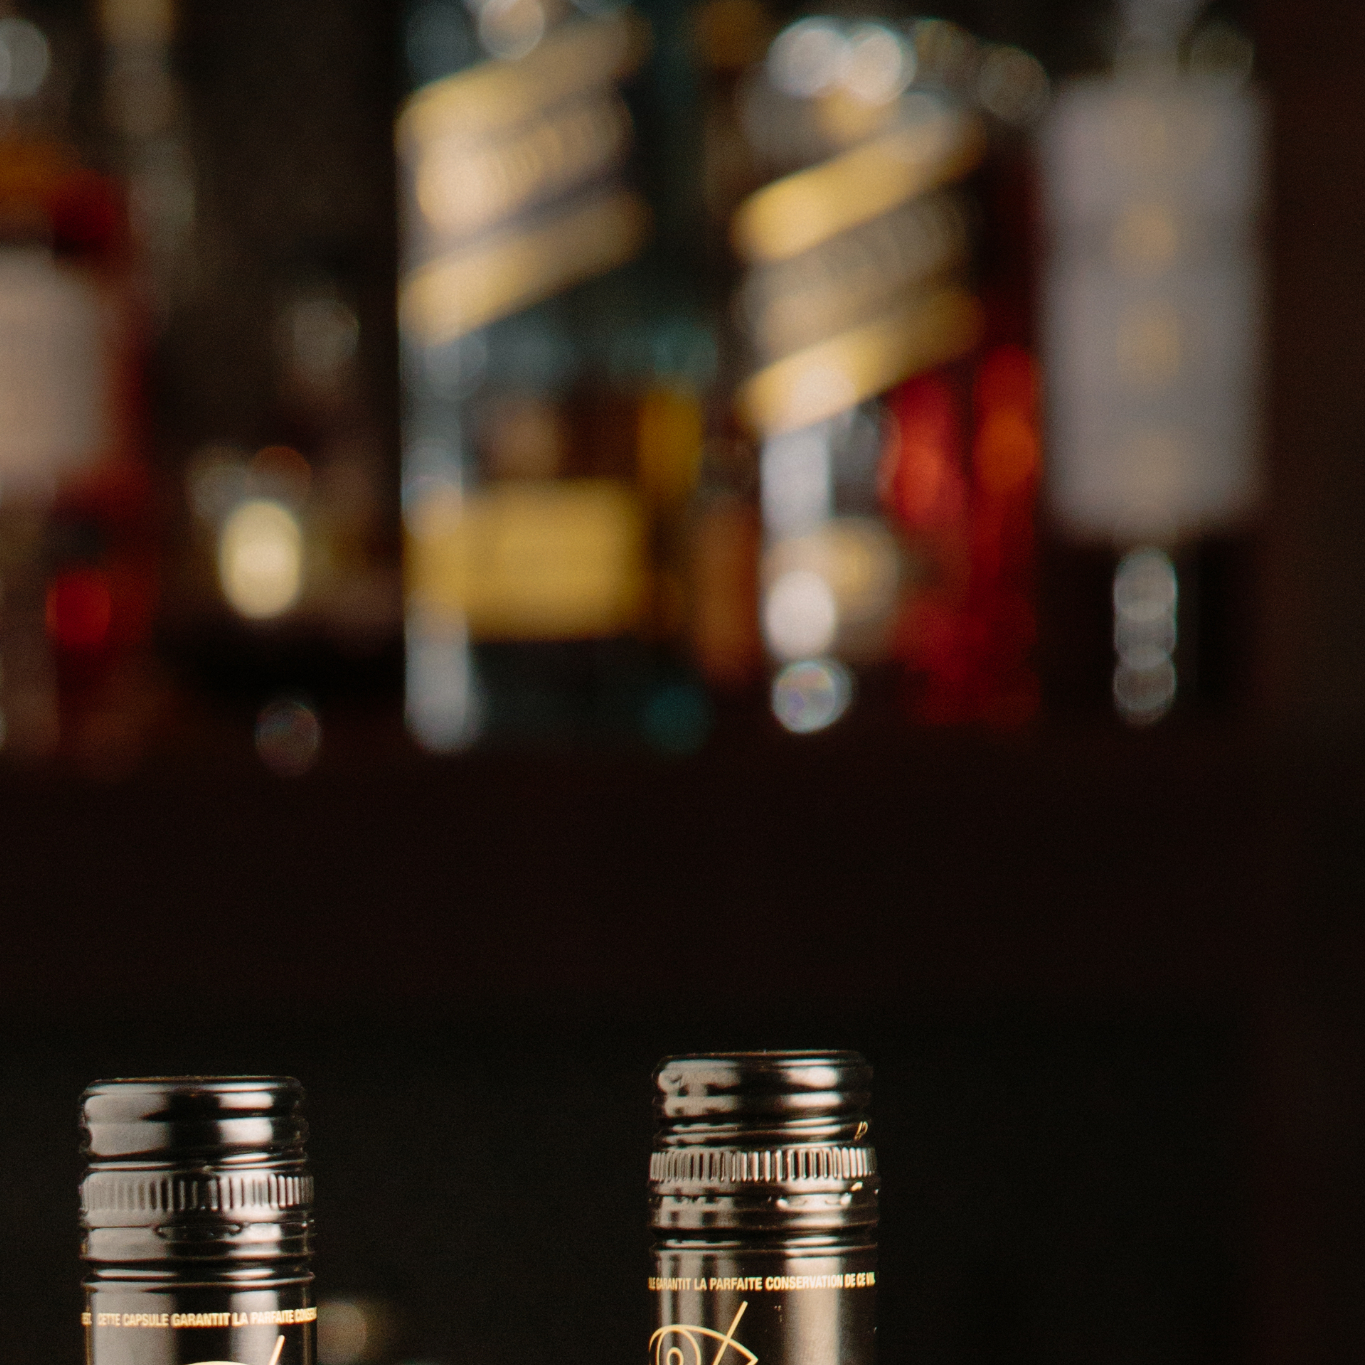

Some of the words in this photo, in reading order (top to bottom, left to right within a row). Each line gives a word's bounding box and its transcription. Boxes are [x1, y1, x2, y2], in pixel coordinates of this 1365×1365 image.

[656, 1277, 691, 1291] GARANTIT
[694, 1277, 707, 1291] LA
[710, 1277, 762, 1291] PARFAITE
[765, 1274, 843, 1291] CONSERVATION
[97, 1312, 120, 1326] CETTE
[122, 1312, 168, 1326] CAPSULE
[171, 1312, 230, 1327] GARANTIT
[233, 1312, 247, 1326] LA
[250, 1310, 293, 1325] PARFAITE
